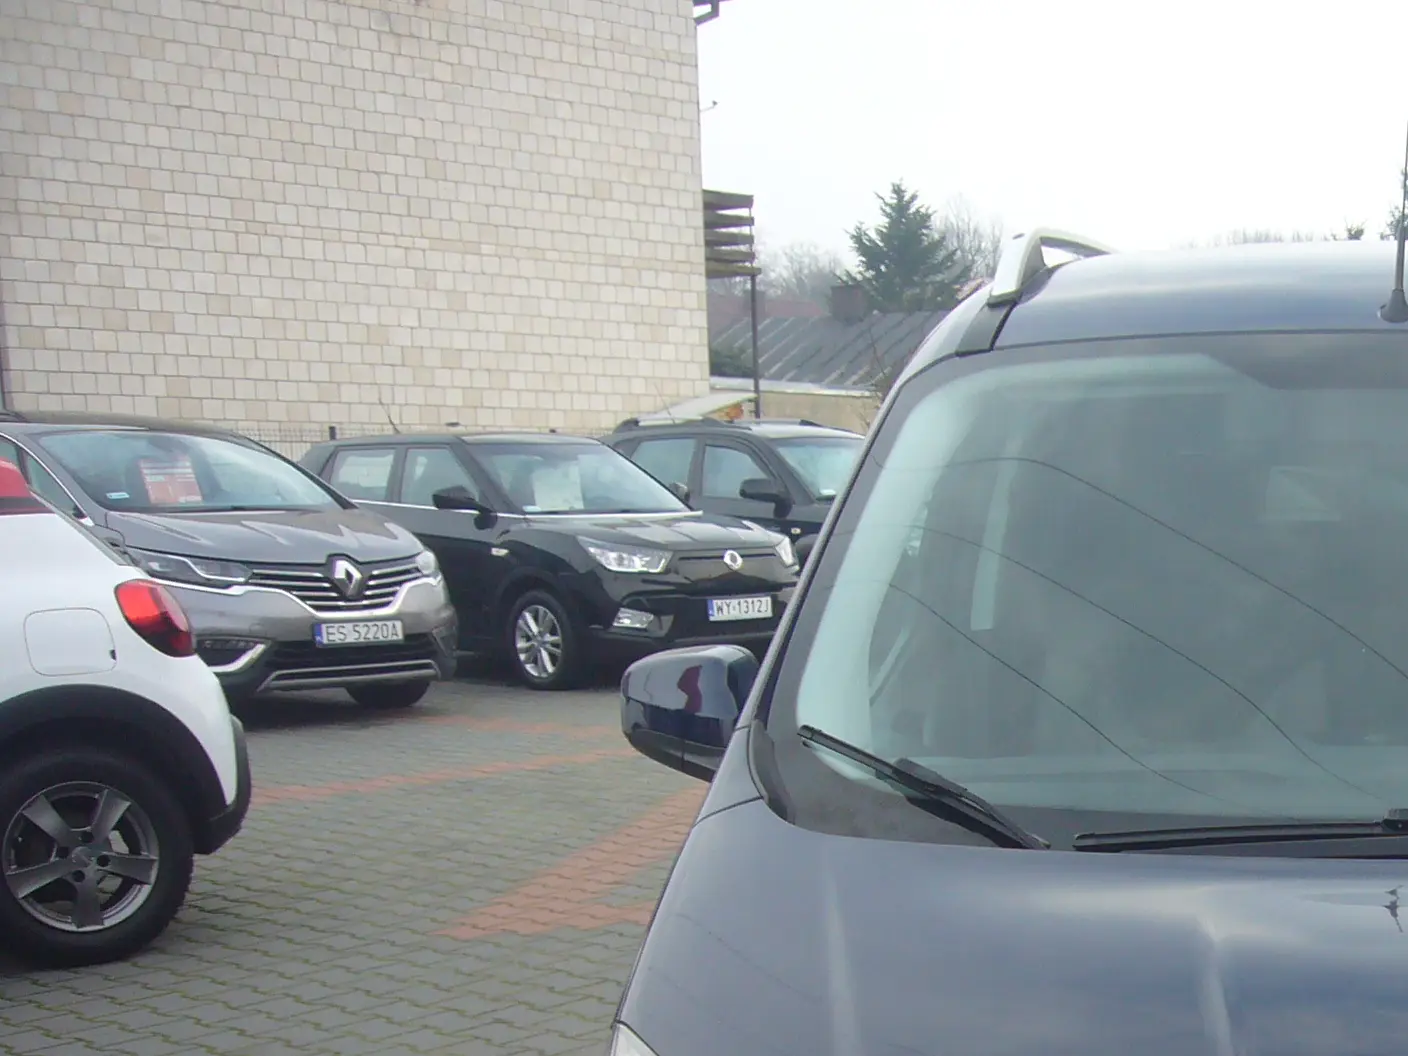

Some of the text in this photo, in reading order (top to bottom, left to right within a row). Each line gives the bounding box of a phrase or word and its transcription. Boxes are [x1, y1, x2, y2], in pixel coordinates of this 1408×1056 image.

[716, 600, 731, 616] WY
[325, 622, 400, 642] ES 5220A
